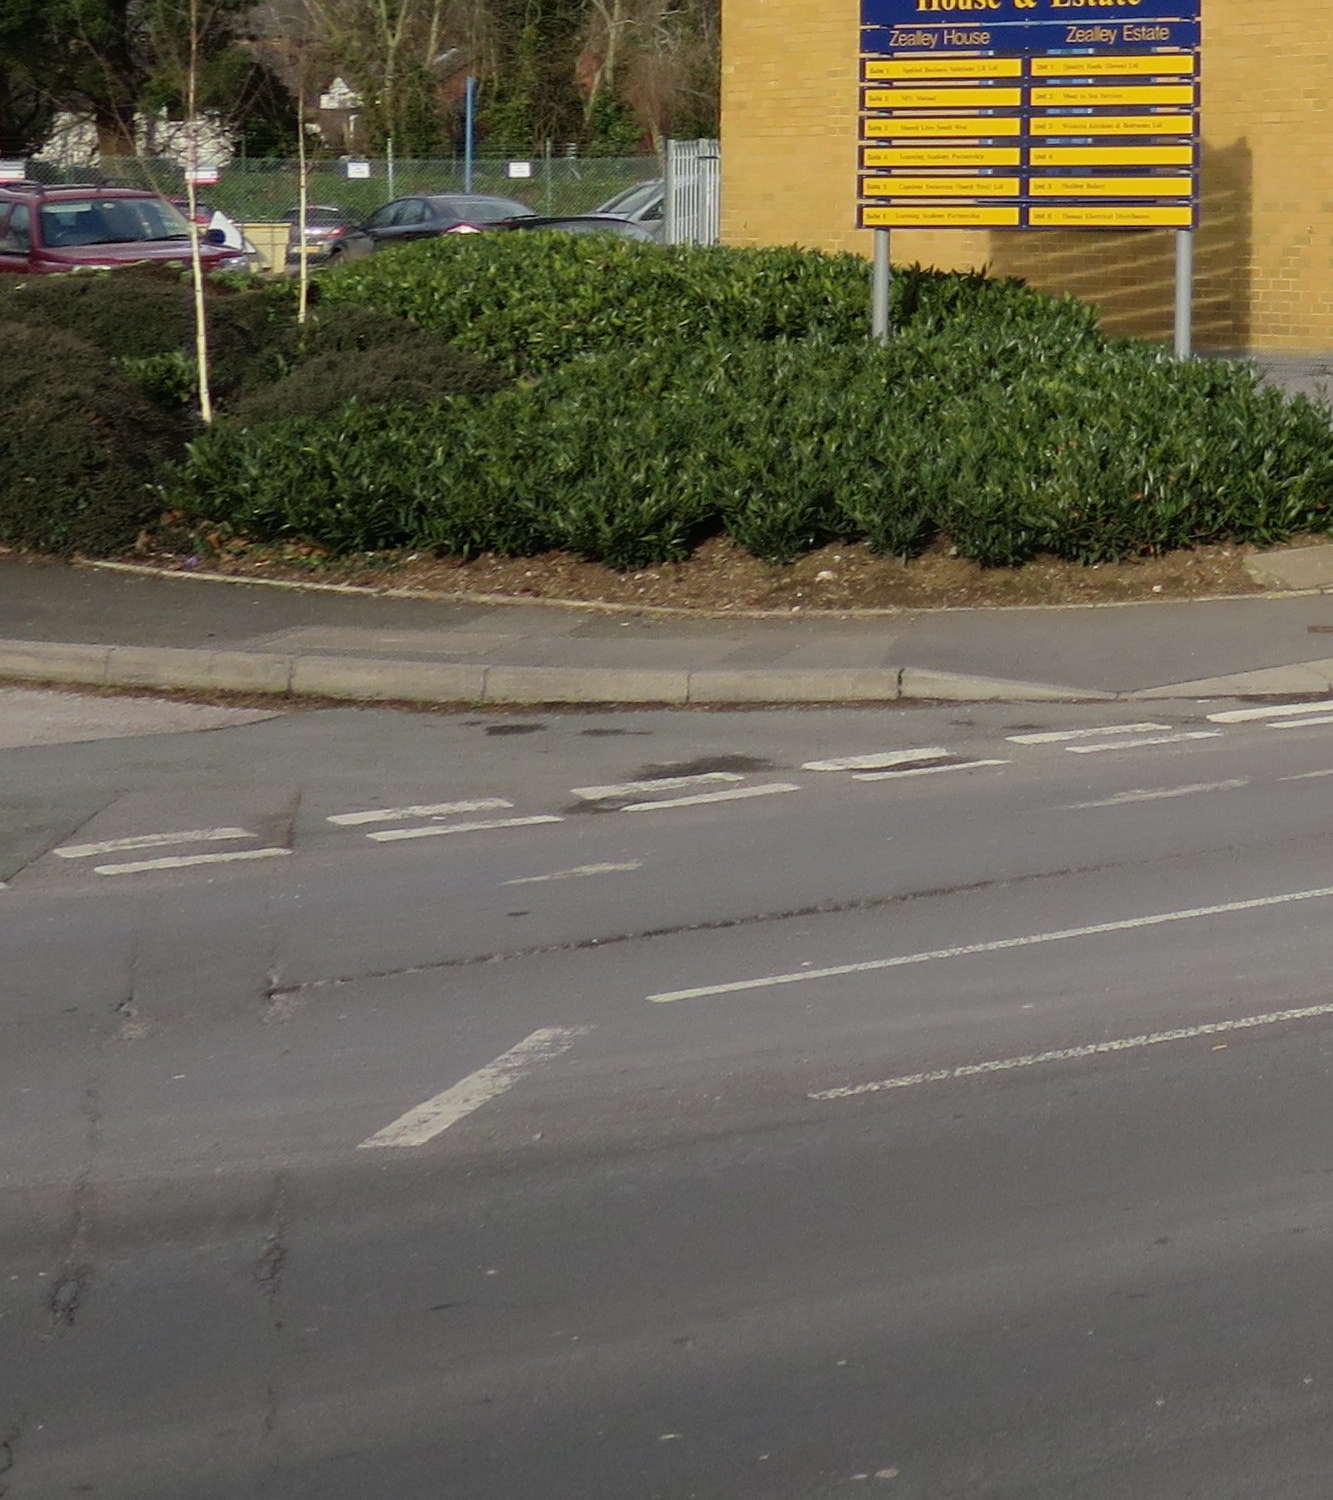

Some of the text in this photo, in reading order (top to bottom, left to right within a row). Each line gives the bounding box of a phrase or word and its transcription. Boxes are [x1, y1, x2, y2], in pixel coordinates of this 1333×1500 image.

[889, 28, 991, 47] Zealley House
[1066, 24, 1169, 44] Zealley Estate
